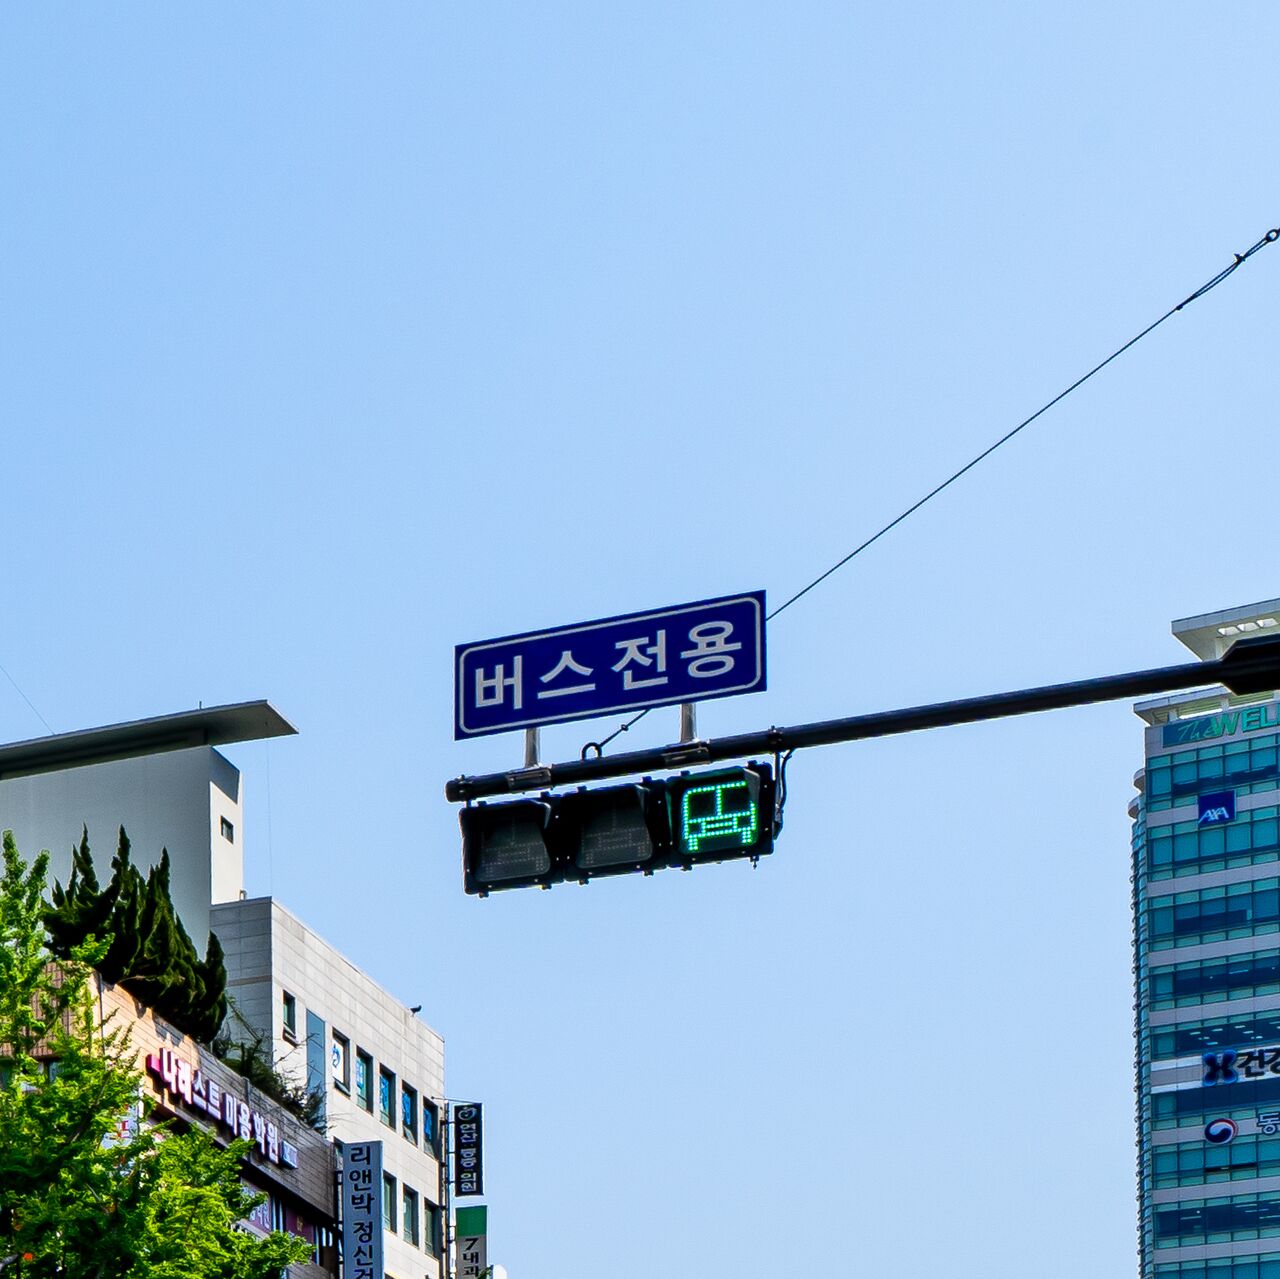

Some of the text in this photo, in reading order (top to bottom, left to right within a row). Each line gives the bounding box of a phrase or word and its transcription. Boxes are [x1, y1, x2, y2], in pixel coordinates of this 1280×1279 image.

[1209, 703, 1280, 737] WEL
[1197, 806, 1230, 824] AXA
[349, 1145, 375, 1215] 리앤박
